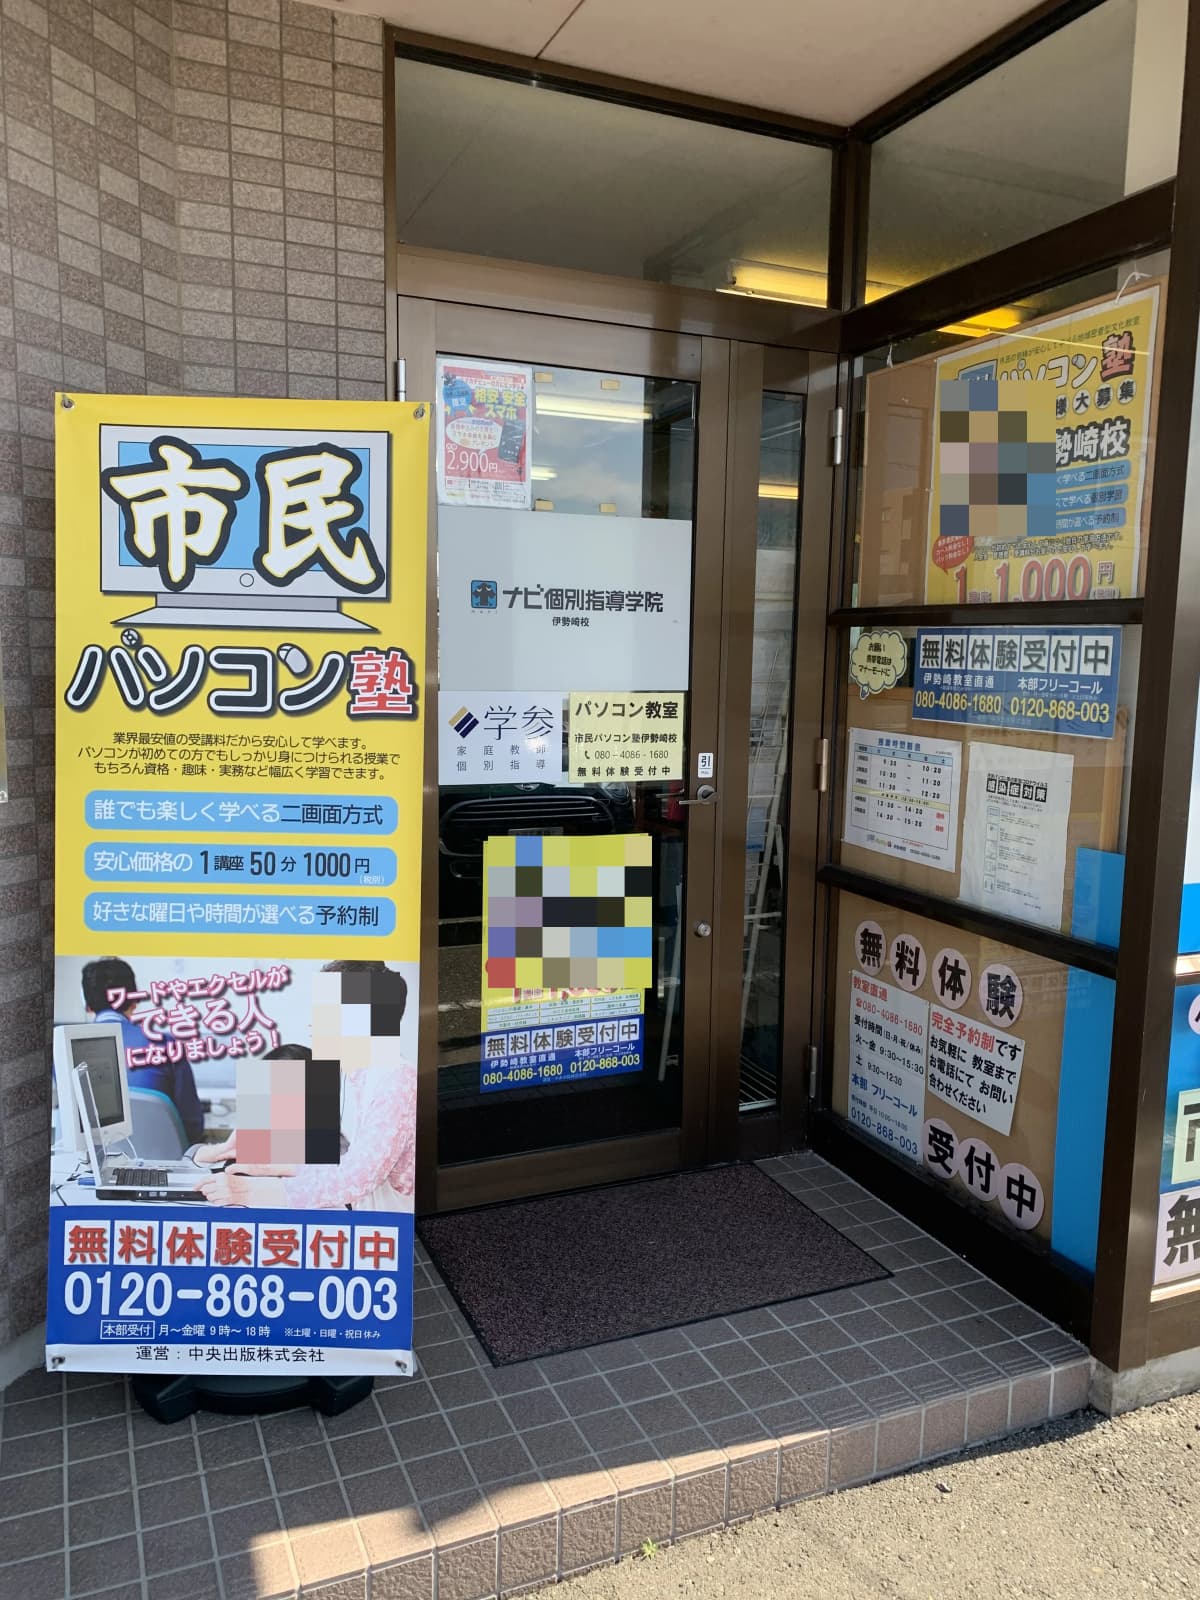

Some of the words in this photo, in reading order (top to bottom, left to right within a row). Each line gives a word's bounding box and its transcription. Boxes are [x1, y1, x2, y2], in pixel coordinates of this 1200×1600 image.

[101, 436, 385, 594] 市民
[502, 584, 664, 613] ナビ個別指導学院
[552, 616, 590, 627] 伊勢崎校
[921, 638, 1110, 673] 無料体験受付中
[65, 629, 419, 718] パソコン塾
[923, 672, 994, 689] 伊勢崎教室直通
[1017, 677, 1103, 695] 本部フリーコール
[484, 704, 555, 741] 学参
[575, 701, 680, 719] パソコン教室
[915, 691, 1002, 714] 080-4086-1680
[1010, 697, 1110, 724] 0120-868-003
[78, 746, 401, 766] パソコンが初めての方でもしっかり身につけられる授業で
[113, 732, 367, 751] 業界最安値の受講料だから安心して学べます。
[574, 733, 678, 745] 市民パソコン塾伊勢崎校
[576, 766, 671, 777] 無料体験受付中
[701, 755, 711, 767] 引
[94, 800, 384, 826] 誰でも楽しく学べる二画面方式
[93, 901, 379, 928] 好きな曜日や時間が選べる予約制
[107, 965, 290, 1009] ワードやエクセルが
[860, 928, 1018, 1020] 無料体験
[131, 993, 276, 1041] できる人
[487, 1021, 638, 1058] 無料体験受付中
[574, 1043, 636, 1059] 本部フリーコール
[932, 1010, 1022, 1062] 完全予約制です
[483, 1063, 564, 1086] 080-4086-1680
[570, 1053, 641, 1074] 0120-868-003
[930, 1034, 968, 1063] お気軽に
[972, 1054, 1017, 1085] 教室まで
[929, 1073, 987, 1113] 合わせください
[930, 1053, 975, 1088] お電話にて
[979, 1080, 1014, 1104] お問い
[872, 1083, 919, 1118] フリーコール
[850, 1107, 919, 1157] 0120-868-003
[927, 1124, 1037, 1219] 受付中
[67, 1225, 397, 1269] 無料体験受付中
[65, 1270, 399, 1321] 0120-868-003
[103, 1323, 152, 1338] 本部受付
